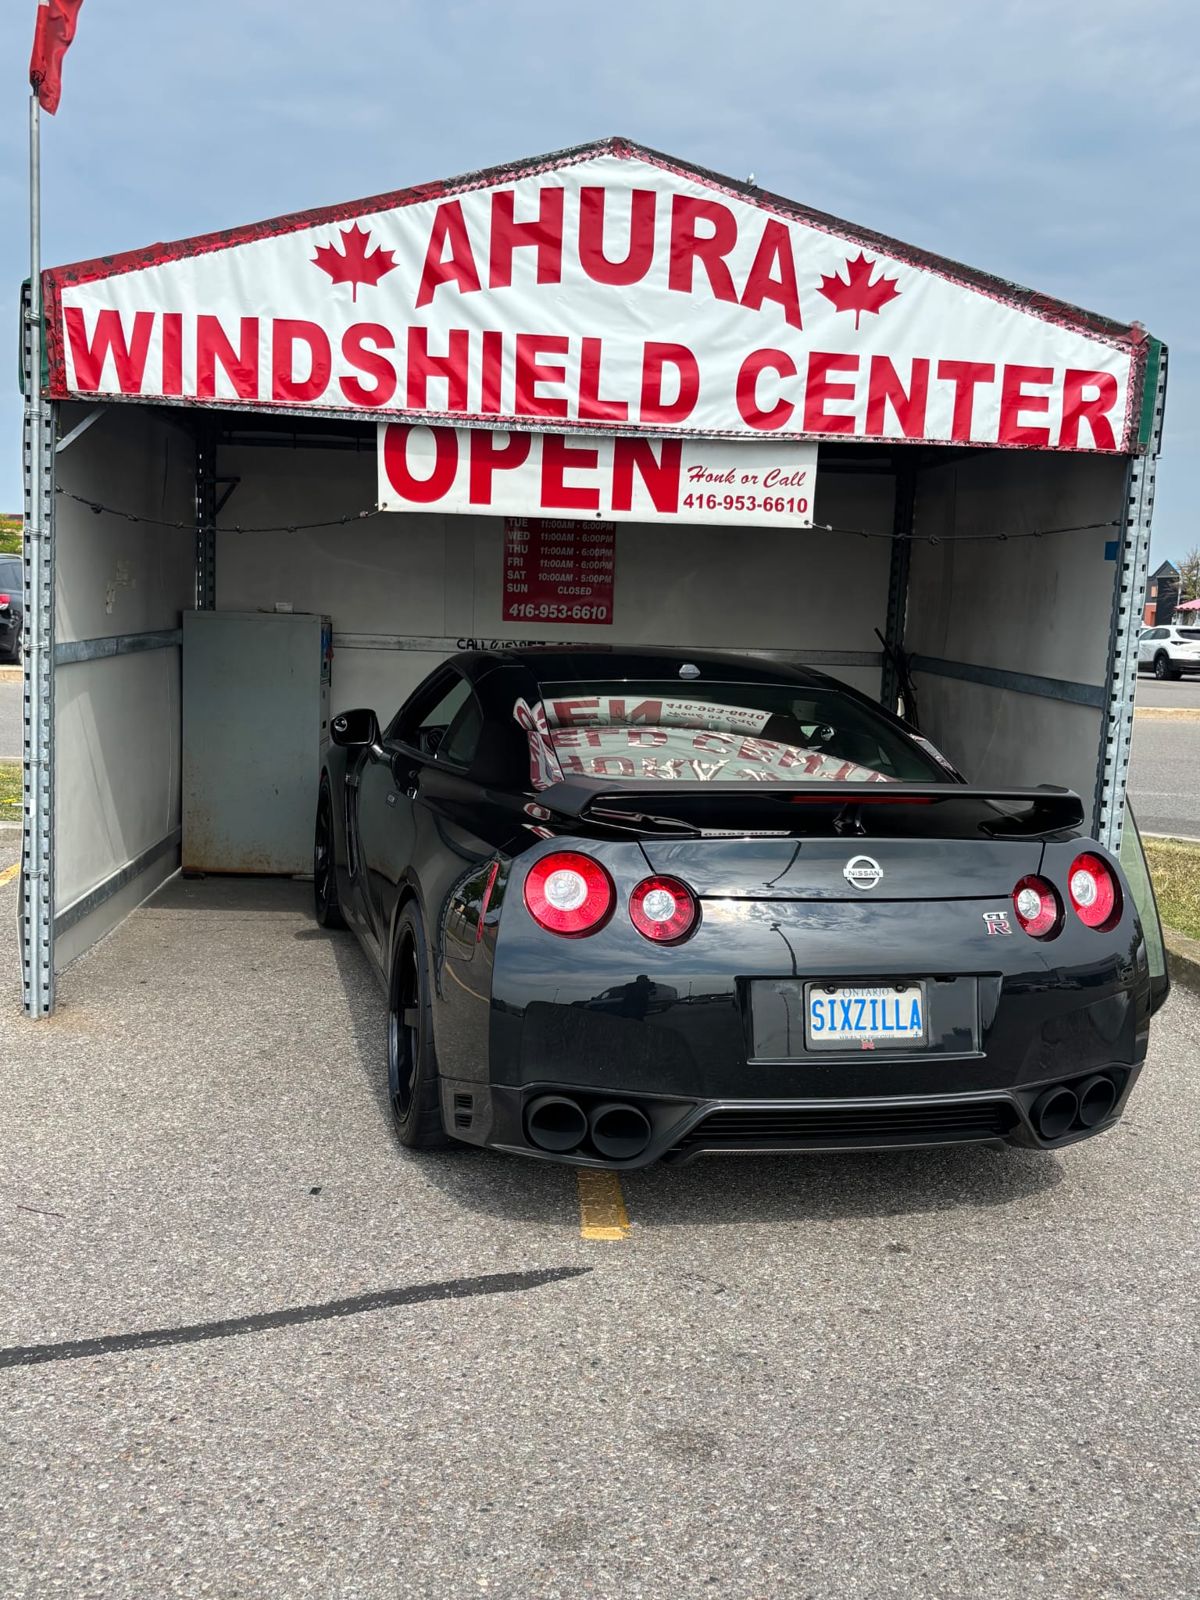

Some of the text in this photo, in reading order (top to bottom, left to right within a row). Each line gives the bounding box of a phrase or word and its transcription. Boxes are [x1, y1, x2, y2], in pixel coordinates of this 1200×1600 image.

[415, 186, 803, 331] AHURA
[63, 306, 1120, 451] WINDSHIELD CENTER
[384, 422, 683, 514] OPEN
[687, 465, 807, 489] Honk or Call
[683, 493, 808, 514] 416-953-6610
[507, 518, 529, 528] TUE
[507, 531, 531, 541] WED
[540, 532, 574, 542] 11:00AM
[507, 544, 529, 554] THU
[540, 546, 574, 555] 11:00AM
[507, 557, 524, 567] FRI
[539, 559, 574, 568] 11:00AM
[507, 570, 527, 580] SAT
[538, 572, 574, 582] 10:00AM
[580, 574, 612, 584] 5:00PM
[507, 583, 592, 595] SUN CLOSED
[509, 603, 607, 620] 416-953-6610
[456, 638, 488, 651] CALL
[842, 987, 890, 998] ONTARIO
[811, 998, 922, 1031] SIXZILLA
